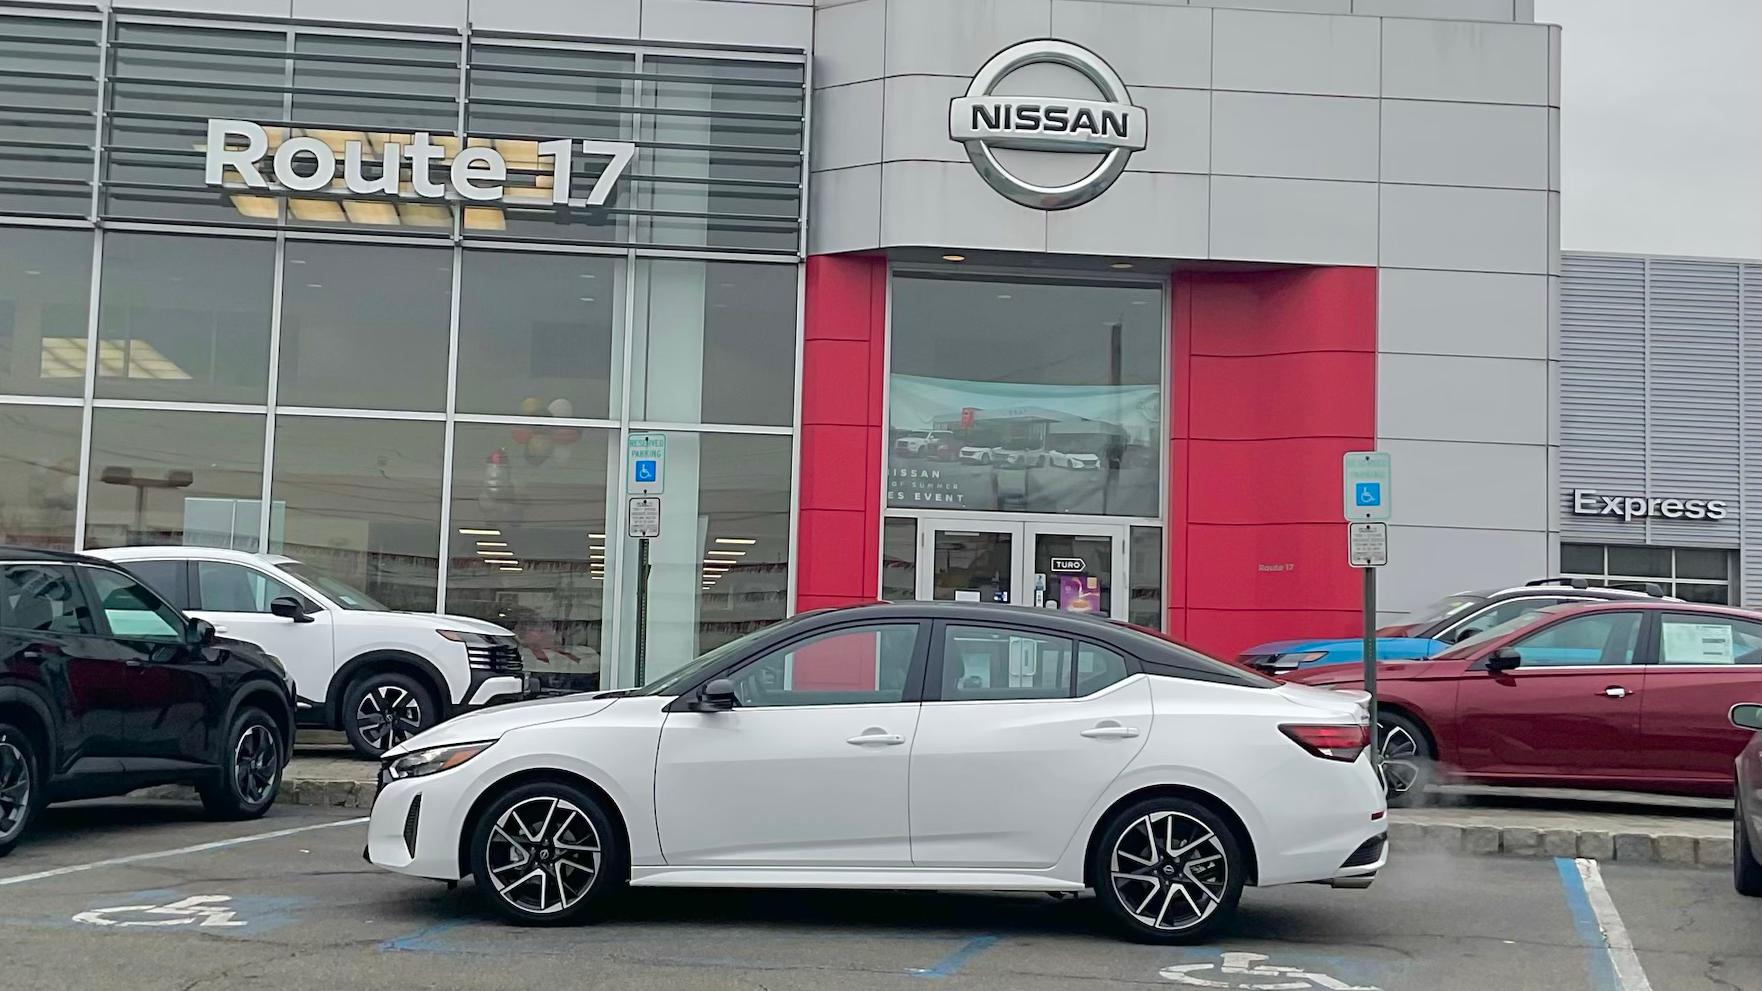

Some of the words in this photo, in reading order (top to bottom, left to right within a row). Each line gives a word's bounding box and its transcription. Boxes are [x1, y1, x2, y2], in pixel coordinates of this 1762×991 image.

[971, 104, 1129, 138] NISSAN
[205, 119, 506, 200] Route
[537, 139, 635, 208] 17
[888, 468, 940, 478] ISSAN
[912, 482, 958, 490] SUMMER
[914, 492, 964, 502] EVENT
[1573, 489, 1728, 522] Express
[1056, 561, 1081, 569] TURO
[1285, 563, 1294, 571] 17
